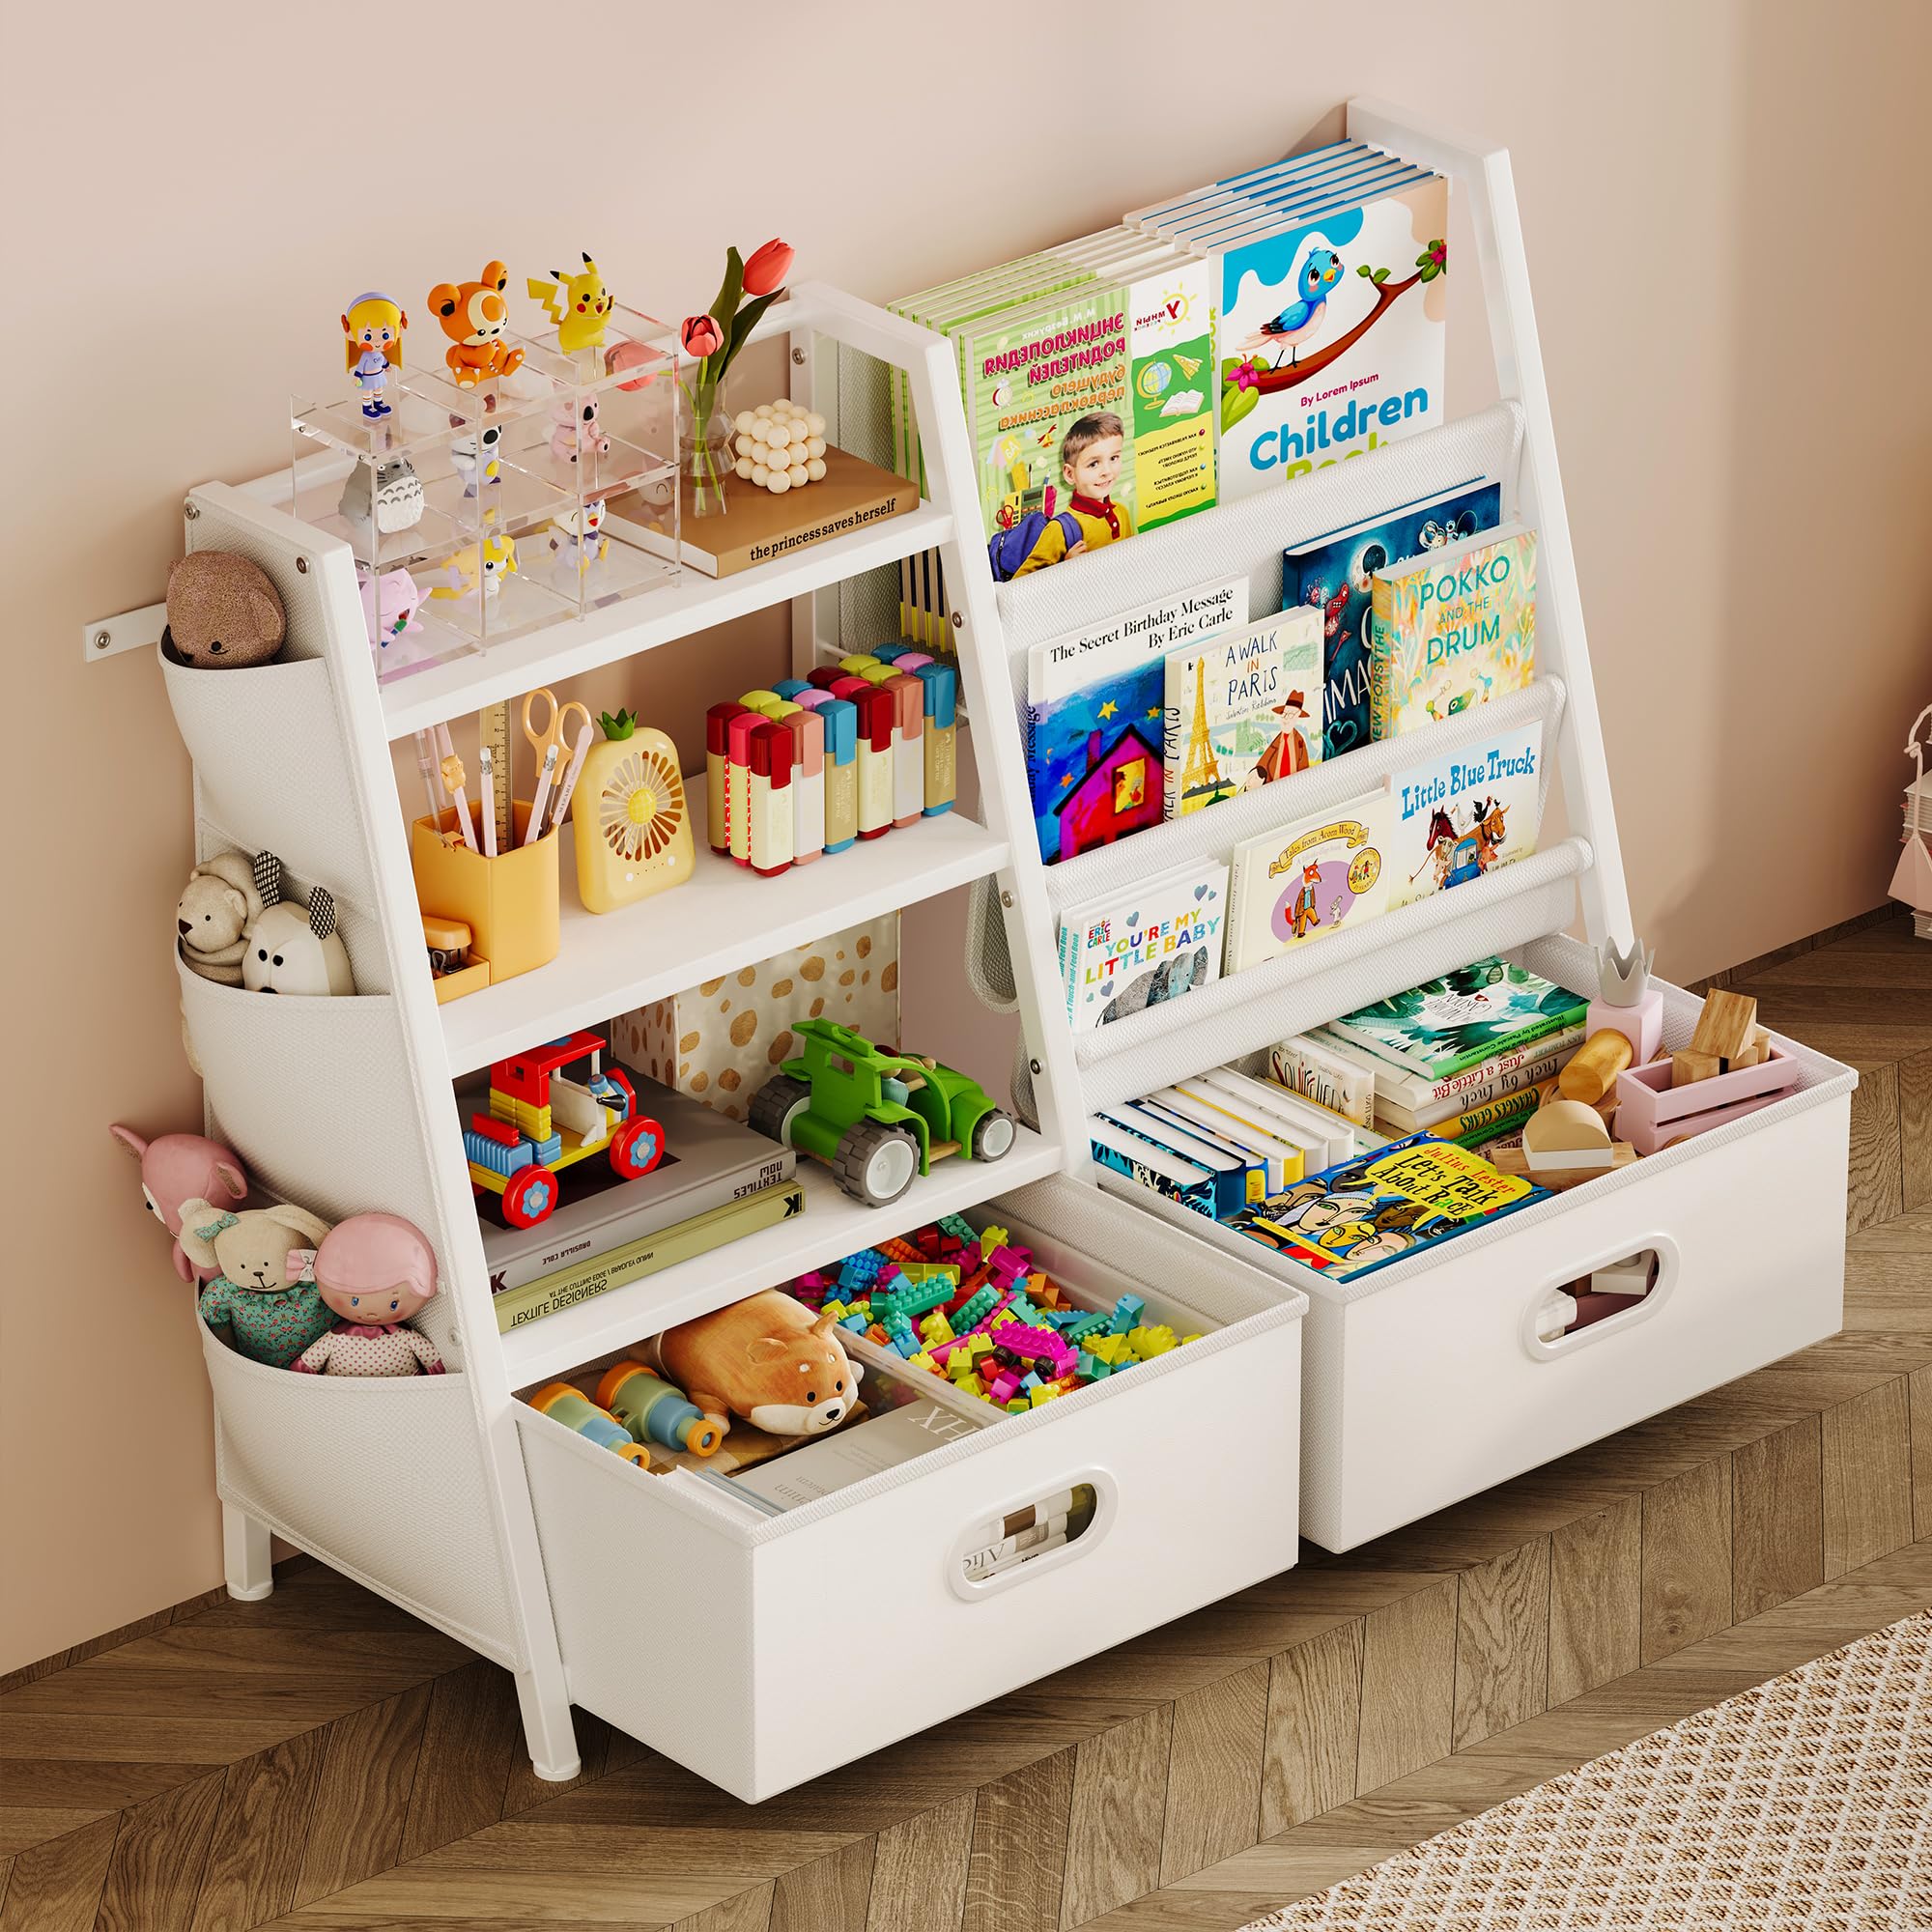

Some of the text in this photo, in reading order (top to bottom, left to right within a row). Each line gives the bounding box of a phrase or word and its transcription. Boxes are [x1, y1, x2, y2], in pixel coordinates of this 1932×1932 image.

[1300, 373, 1379, 408] By Lorem Ipsum
[1249, 386, 1429, 471] Children
[750, 497, 896, 561] the princess saves herself
[1419, 554, 1510, 612] POKKO
[1051, 586, 1235, 664] The Secret Birthday Message
[1148, 607, 1234, 650] By Eric Carle
[1437, 594, 1490, 626] AND THE
[1225, 631, 1278, 668] A WALK
[1426, 613, 1500, 666] DRUM
[1228, 666, 1278, 706] PARIS
[1246, 658, 1260, 674] IN
[1372, 625, 1385, 708] FORSYTHE
[1401, 747, 1536, 821] Little Blue Truck
[1283, 845, 1301, 860] Tales
[1301, 837, 1318, 848] from
[1319, 830, 1338, 841] Acorn
[1338, 823, 1356, 837] Wood
[1174, 908, 1202, 932] MY
[1085, 916, 1221, 985] LITTLE BABY
[1087, 932, 1111, 950] CARLE
[1497, 1033, 1522, 1047] Pascale
[1530, 1014, 1565, 1034] Illustrated
[1459, 1042, 1496, 1062] Constantin
[1432, 1053, 1525, 1101] Just a Little Bit
[1459, 1059, 1558, 1112] Inch by Inch
[1459, 1087, 1540, 1135] CHANGES GEARS
[733, 1173, 783, 1200] TEXTILES
[1370, 1164, 1430, 1196] About
[1395, 1153, 1447, 1183] Let's
[1440, 1175, 1500, 1207] Talk
[1423, 1146, 1470, 1172] Julius
[1469, 1169, 1517, 1195] Lester
[542, 1239, 591, 1265] DRUSILLA COLE
